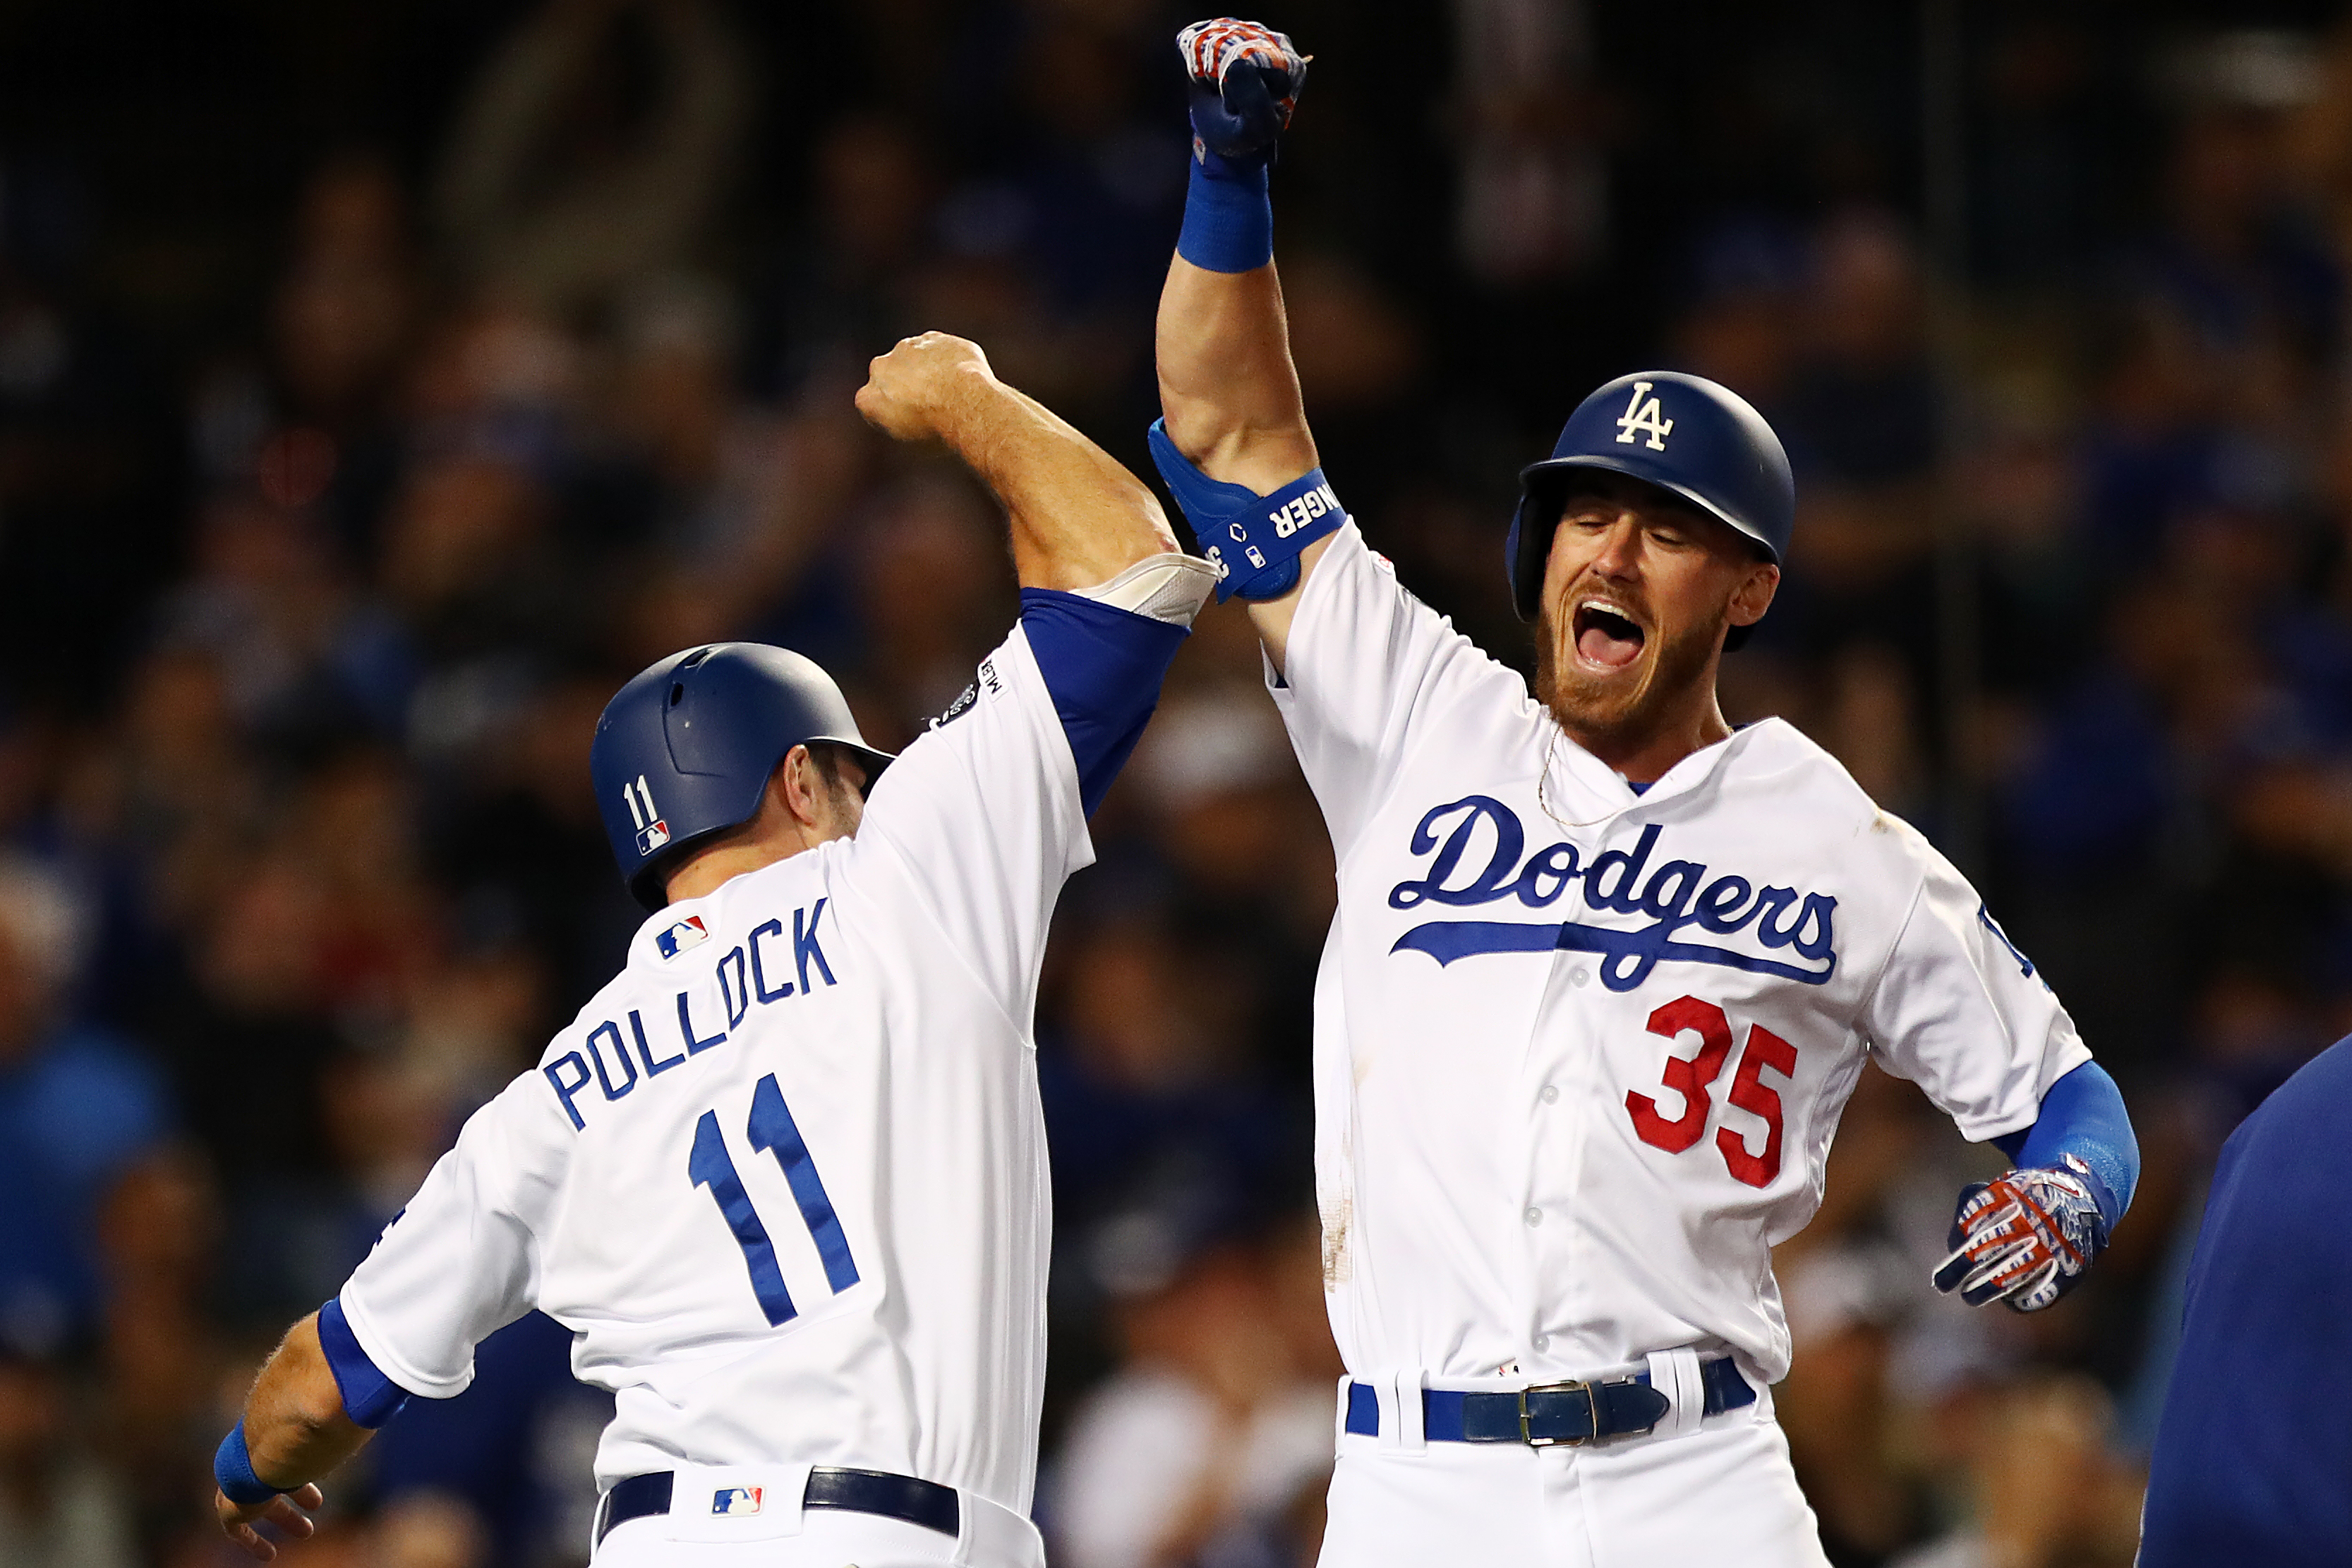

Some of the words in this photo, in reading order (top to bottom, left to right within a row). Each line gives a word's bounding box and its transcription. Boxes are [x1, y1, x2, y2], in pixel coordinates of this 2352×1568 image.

[1616, 382, 1673, 451] LA
[1205, 545, 1230, 584] 3
[624, 775, 658, 830] 11
[1388, 795, 1838, 992] Dodgers
[543, 897, 837, 1133] POLLOCK
[1625, 995, 1797, 1188] 35
[688, 1073, 860, 1328] 11
